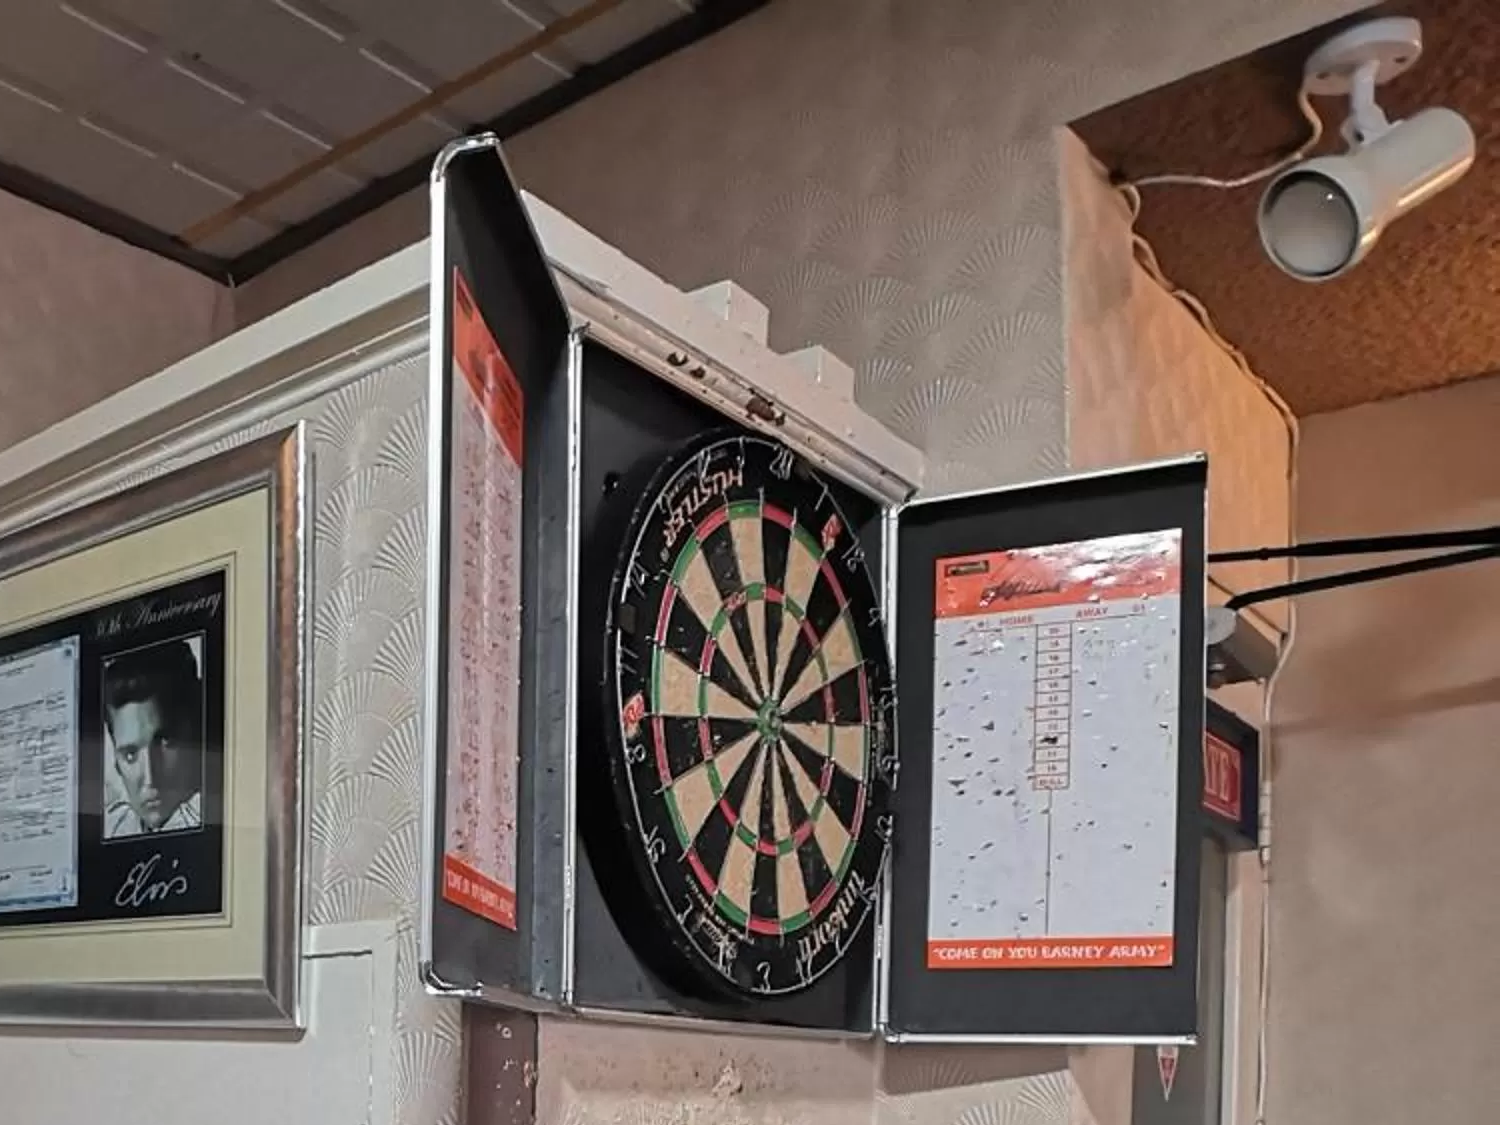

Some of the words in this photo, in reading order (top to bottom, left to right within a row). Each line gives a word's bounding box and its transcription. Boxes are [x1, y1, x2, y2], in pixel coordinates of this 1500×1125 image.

[663, 468, 743, 547] HUSTLER
[115, 853, 188, 907] Elvis
[1008, 946, 1038, 960] YOU
[1042, 945, 1104, 960] BARNEY
